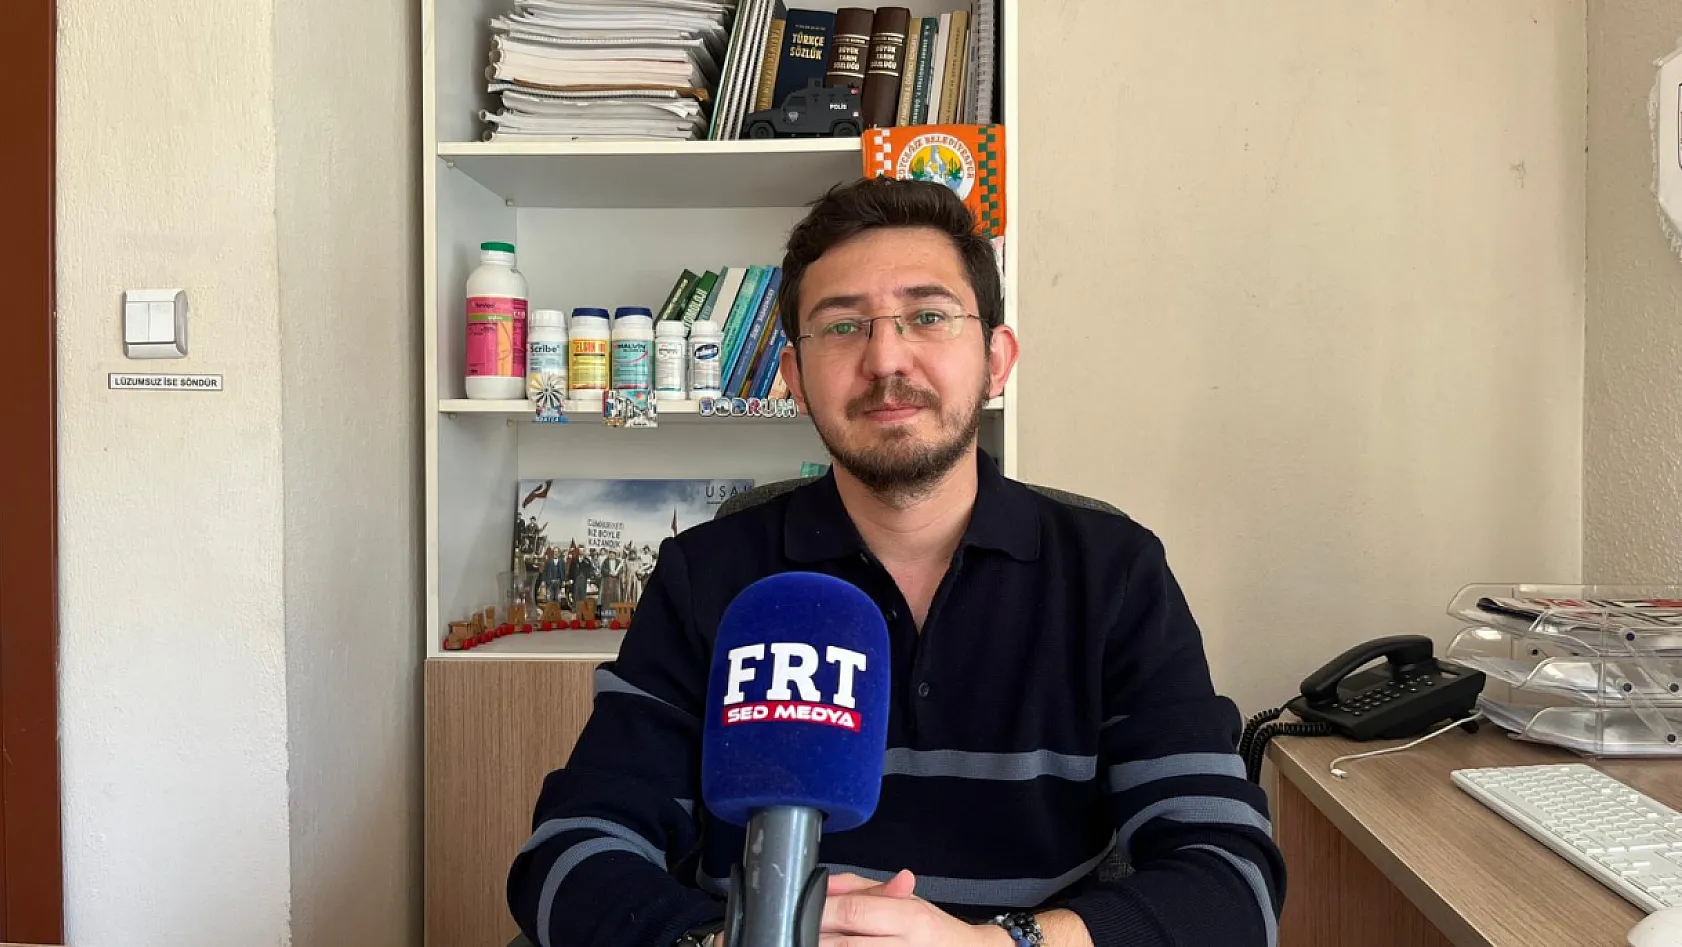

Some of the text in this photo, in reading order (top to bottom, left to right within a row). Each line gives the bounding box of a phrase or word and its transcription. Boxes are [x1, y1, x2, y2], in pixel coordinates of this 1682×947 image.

[792, 31, 825, 47] TÜRKÇE
[789, 45, 823, 60] SÖZLÜK
[115, 377, 217, 387] LÜZUMSUZ İSE SÖNDÜR
[723, 642, 867, 709] FRT
[727, 704, 855, 727] SED MEDYA
